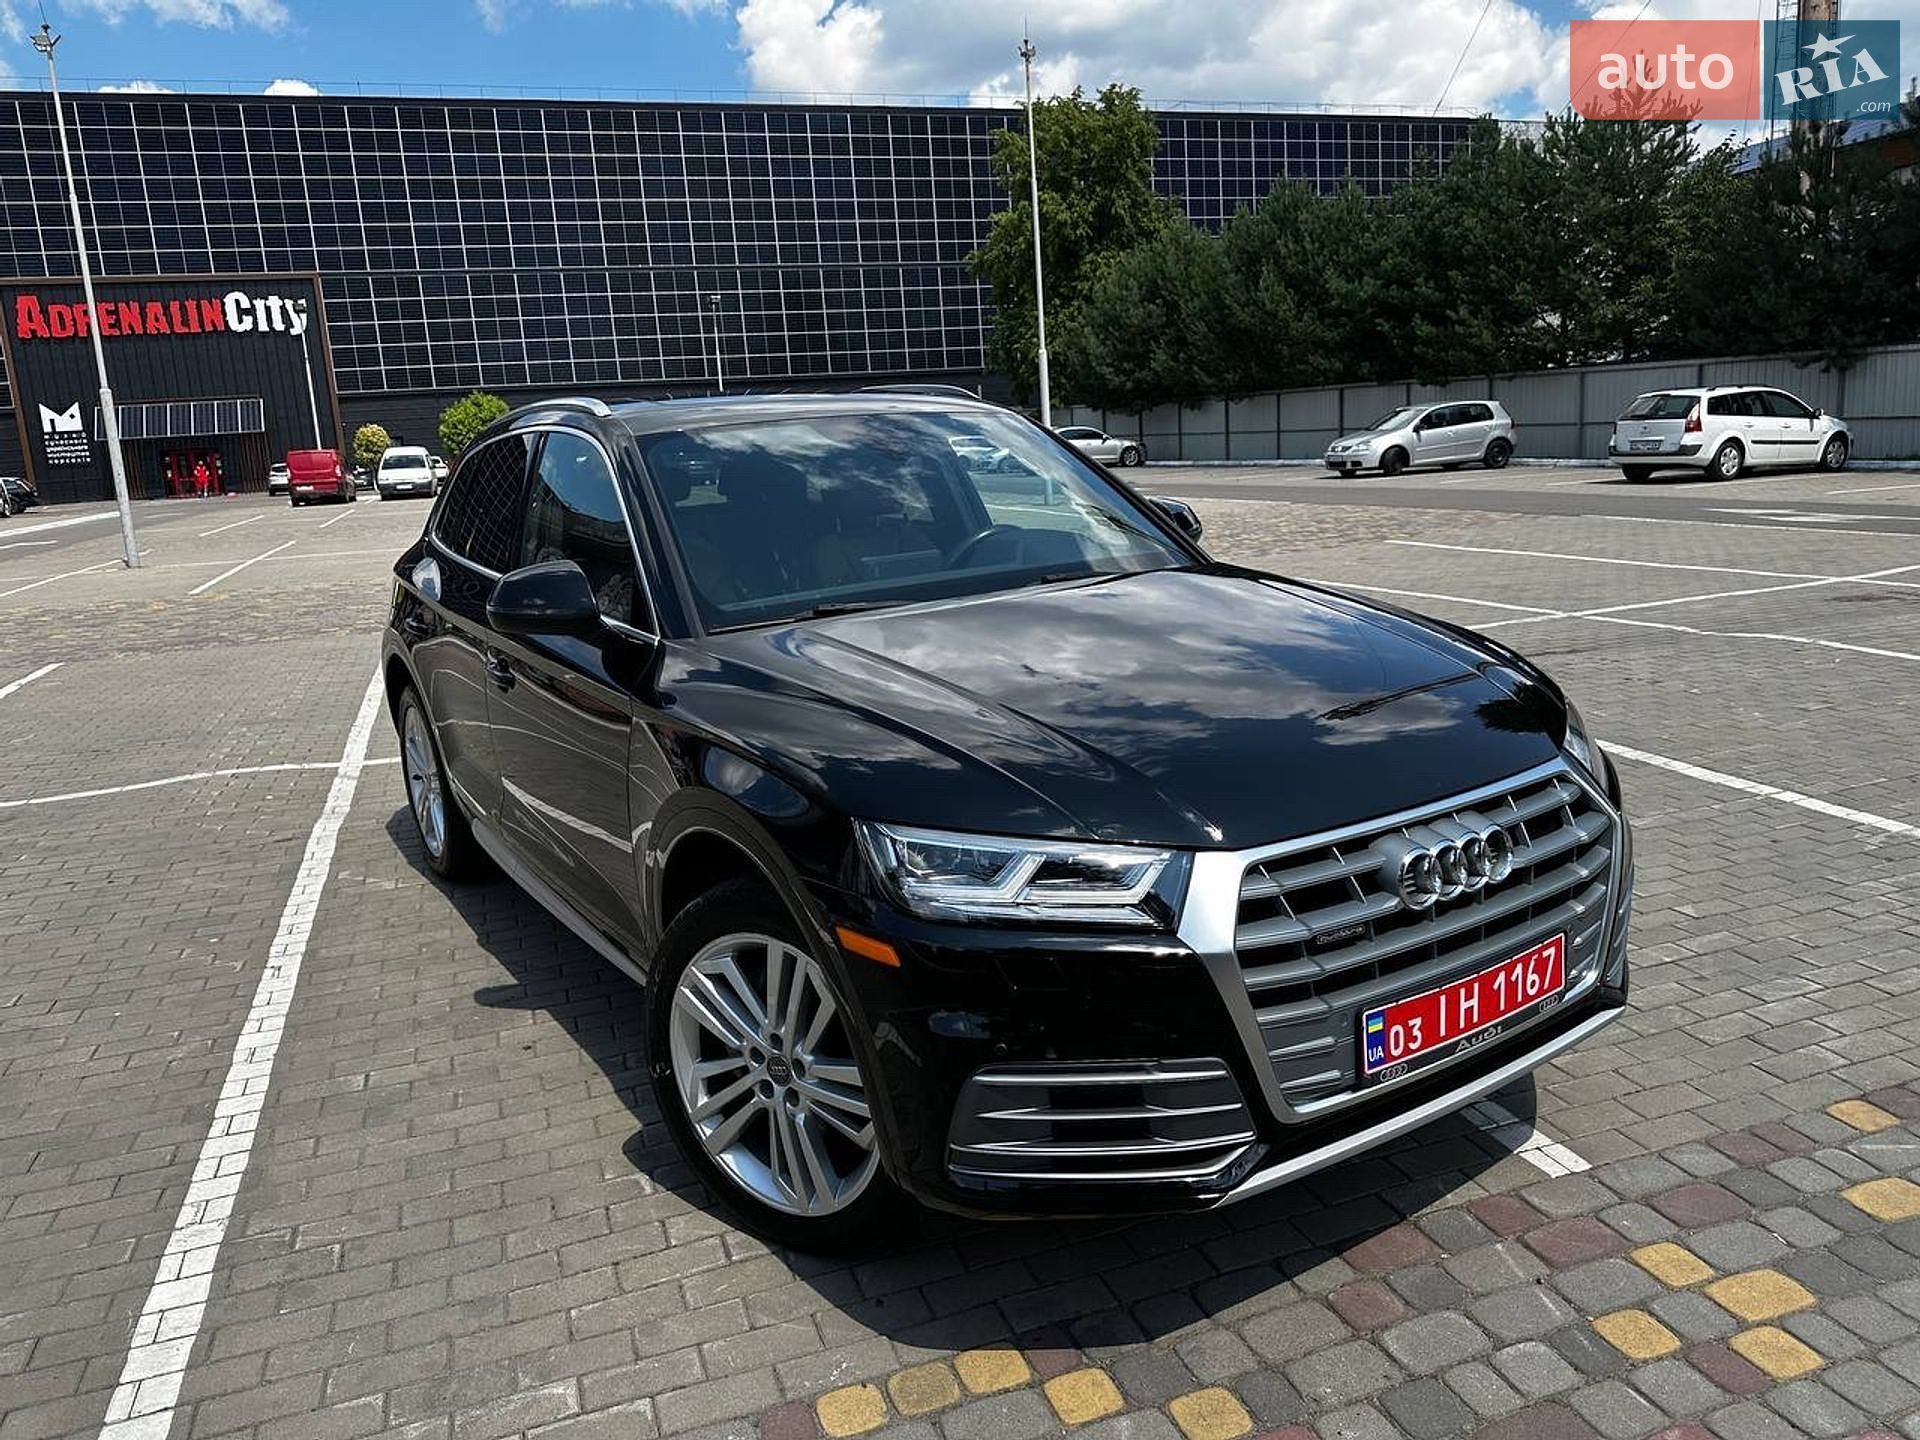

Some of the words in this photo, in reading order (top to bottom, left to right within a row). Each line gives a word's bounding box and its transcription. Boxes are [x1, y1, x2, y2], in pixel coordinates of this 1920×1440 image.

[1389, 1016, 1422, 1057] 03
[1493, 946, 1556, 1011] 1167
[1368, 1045, 1384, 1062] UA
